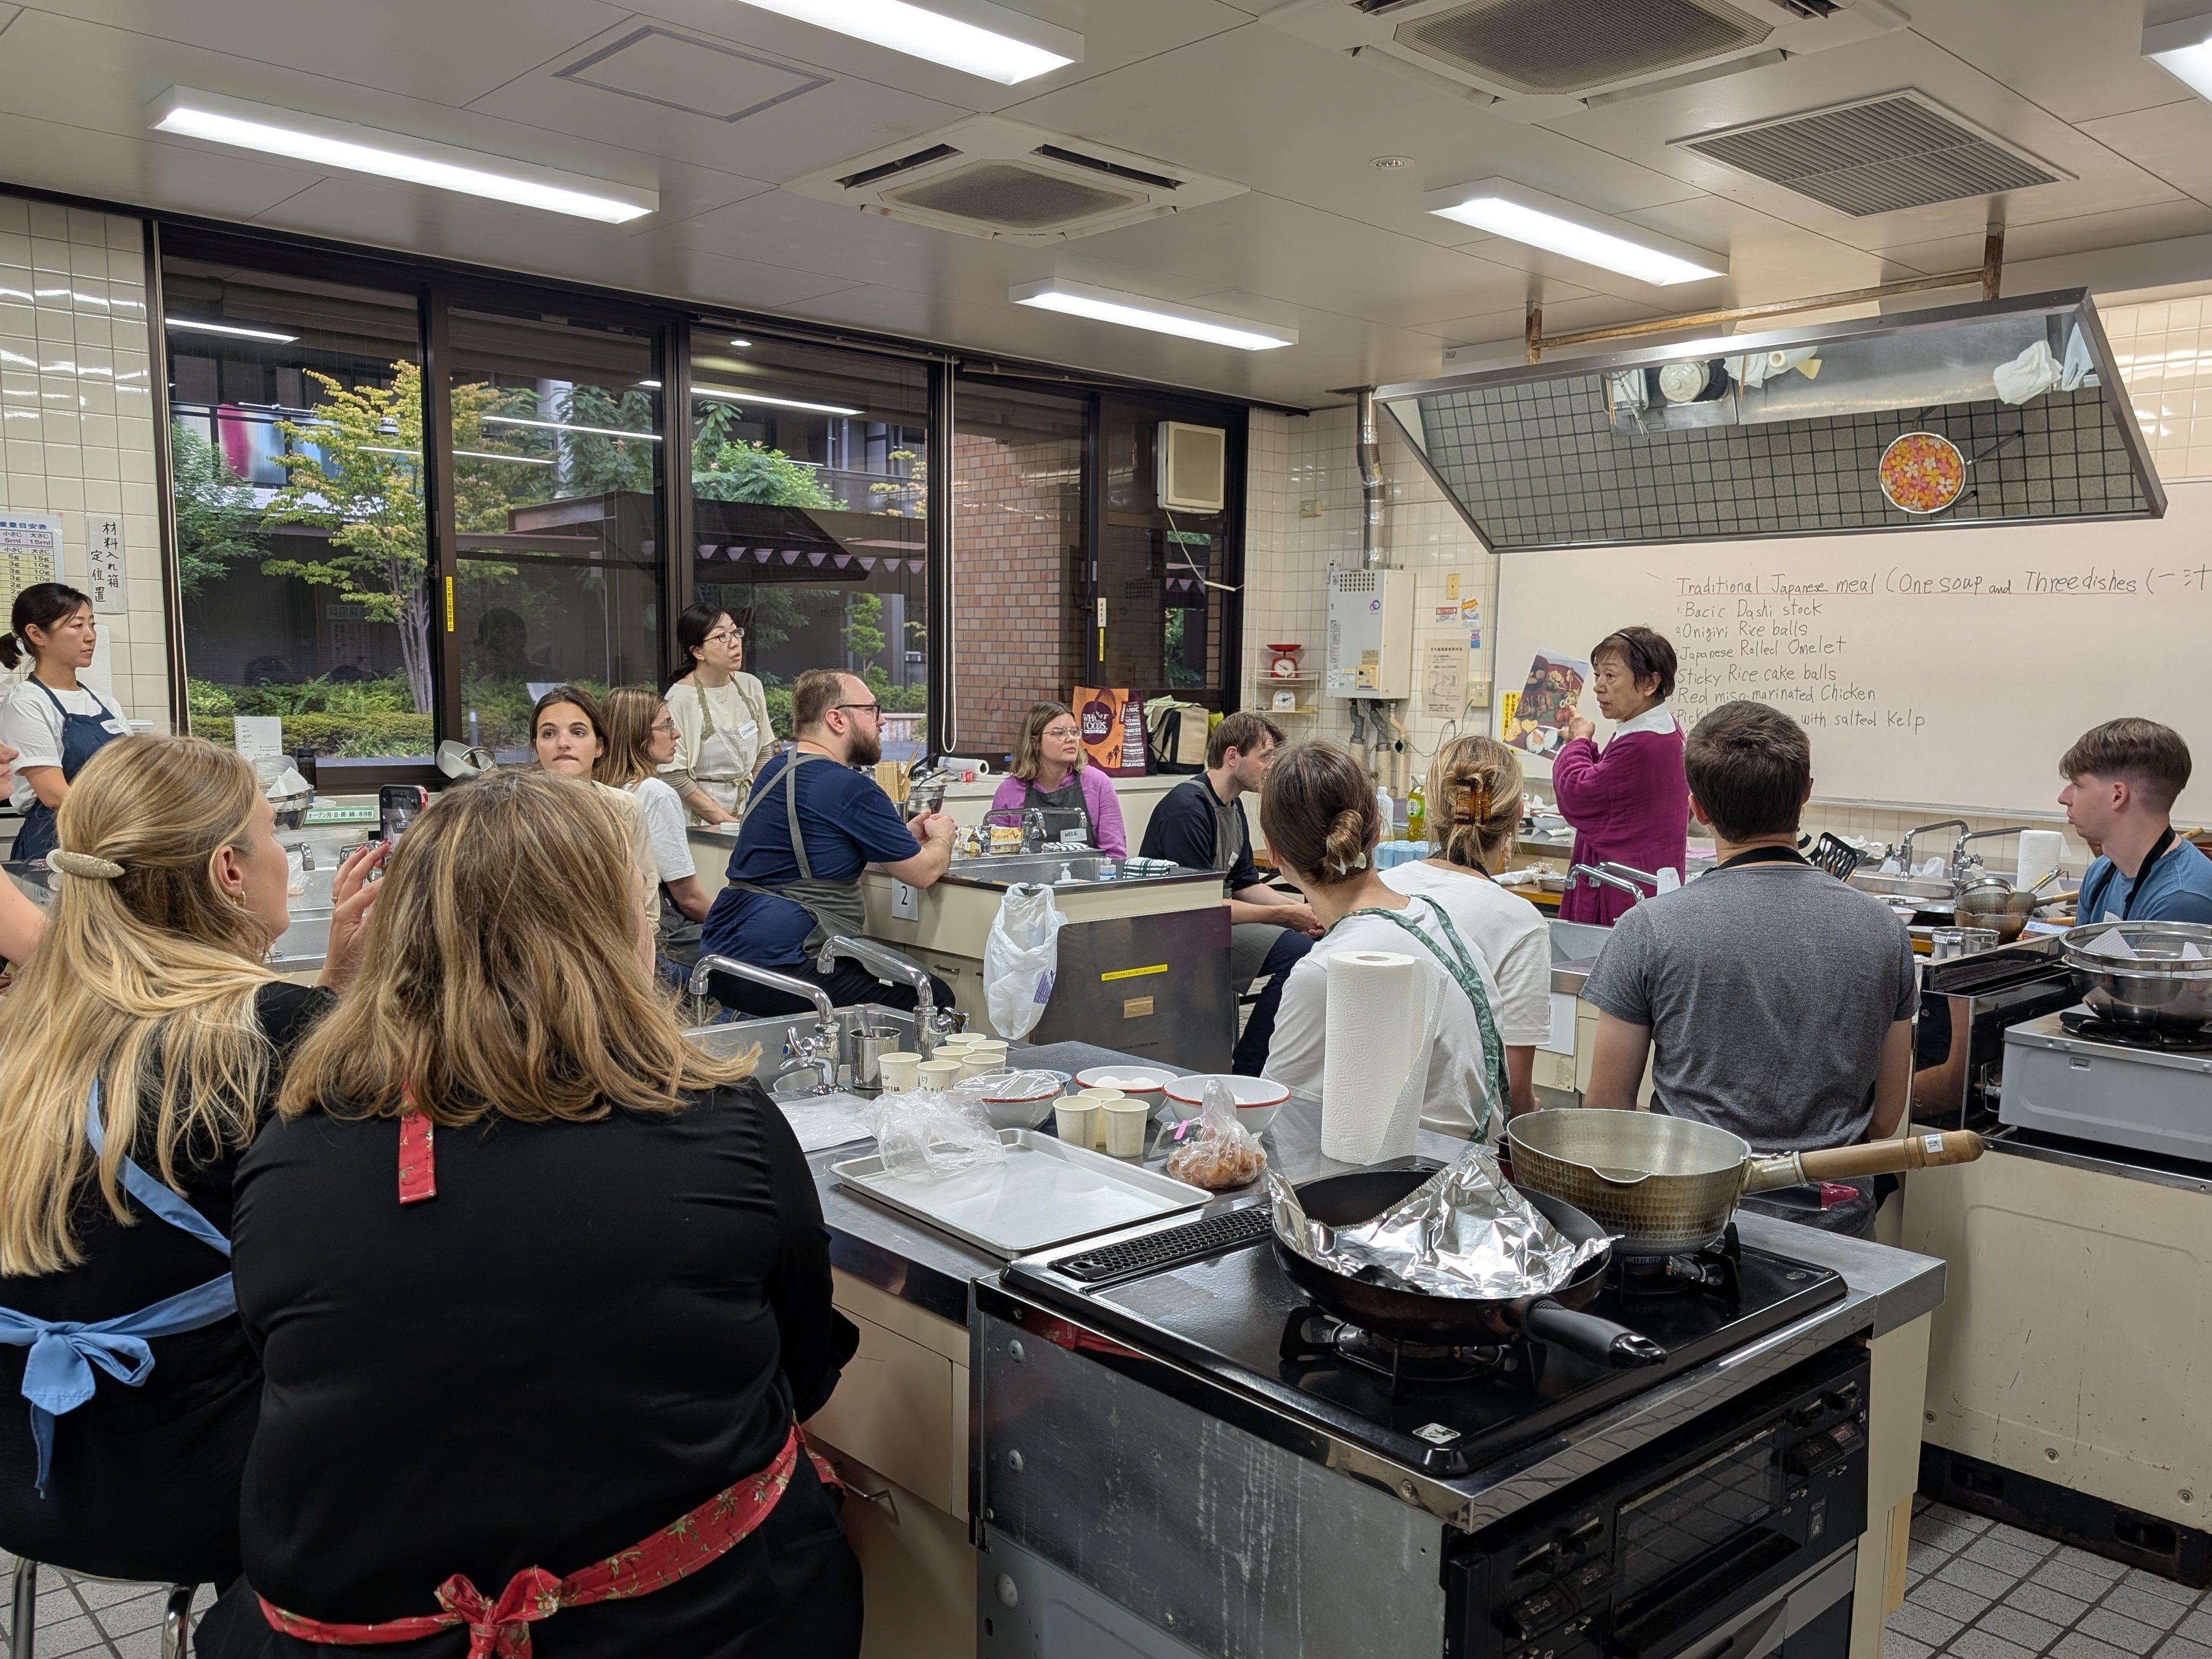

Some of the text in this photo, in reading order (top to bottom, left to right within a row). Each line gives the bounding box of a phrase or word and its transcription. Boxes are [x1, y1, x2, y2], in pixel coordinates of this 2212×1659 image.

[102, 522, 119, 588] 材料入れ箱
[91, 549, 106, 602] 定位置
[1676, 576, 1759, 595] Traditional
[1771, 574, 1829, 600] Japanese
[1836, 573, 1876, 594] meal
[1941, 576, 1983, 596] soup
[1989, 580, 2012, 595] and
[1737, 599, 1773, 620] Dashi
[1783, 599, 1823, 617] stock
[1740, 621, 1765, 637] Rice
[1772, 621, 1808, 637] balls
[1741, 639, 1778, 657] Rolled
[1788, 635, 1846, 655] Omelet
[1678, 663, 1837, 687] Sticky Rice cake balls
[1678, 687, 1708, 706] Red
[1821, 682, 1876, 701] Chicken
[1083, 722, 1107, 730] FOODS
[1801, 710, 1827, 727] with
[1834, 710, 1876, 727] salted
[901, 886, 908, 906] 2
